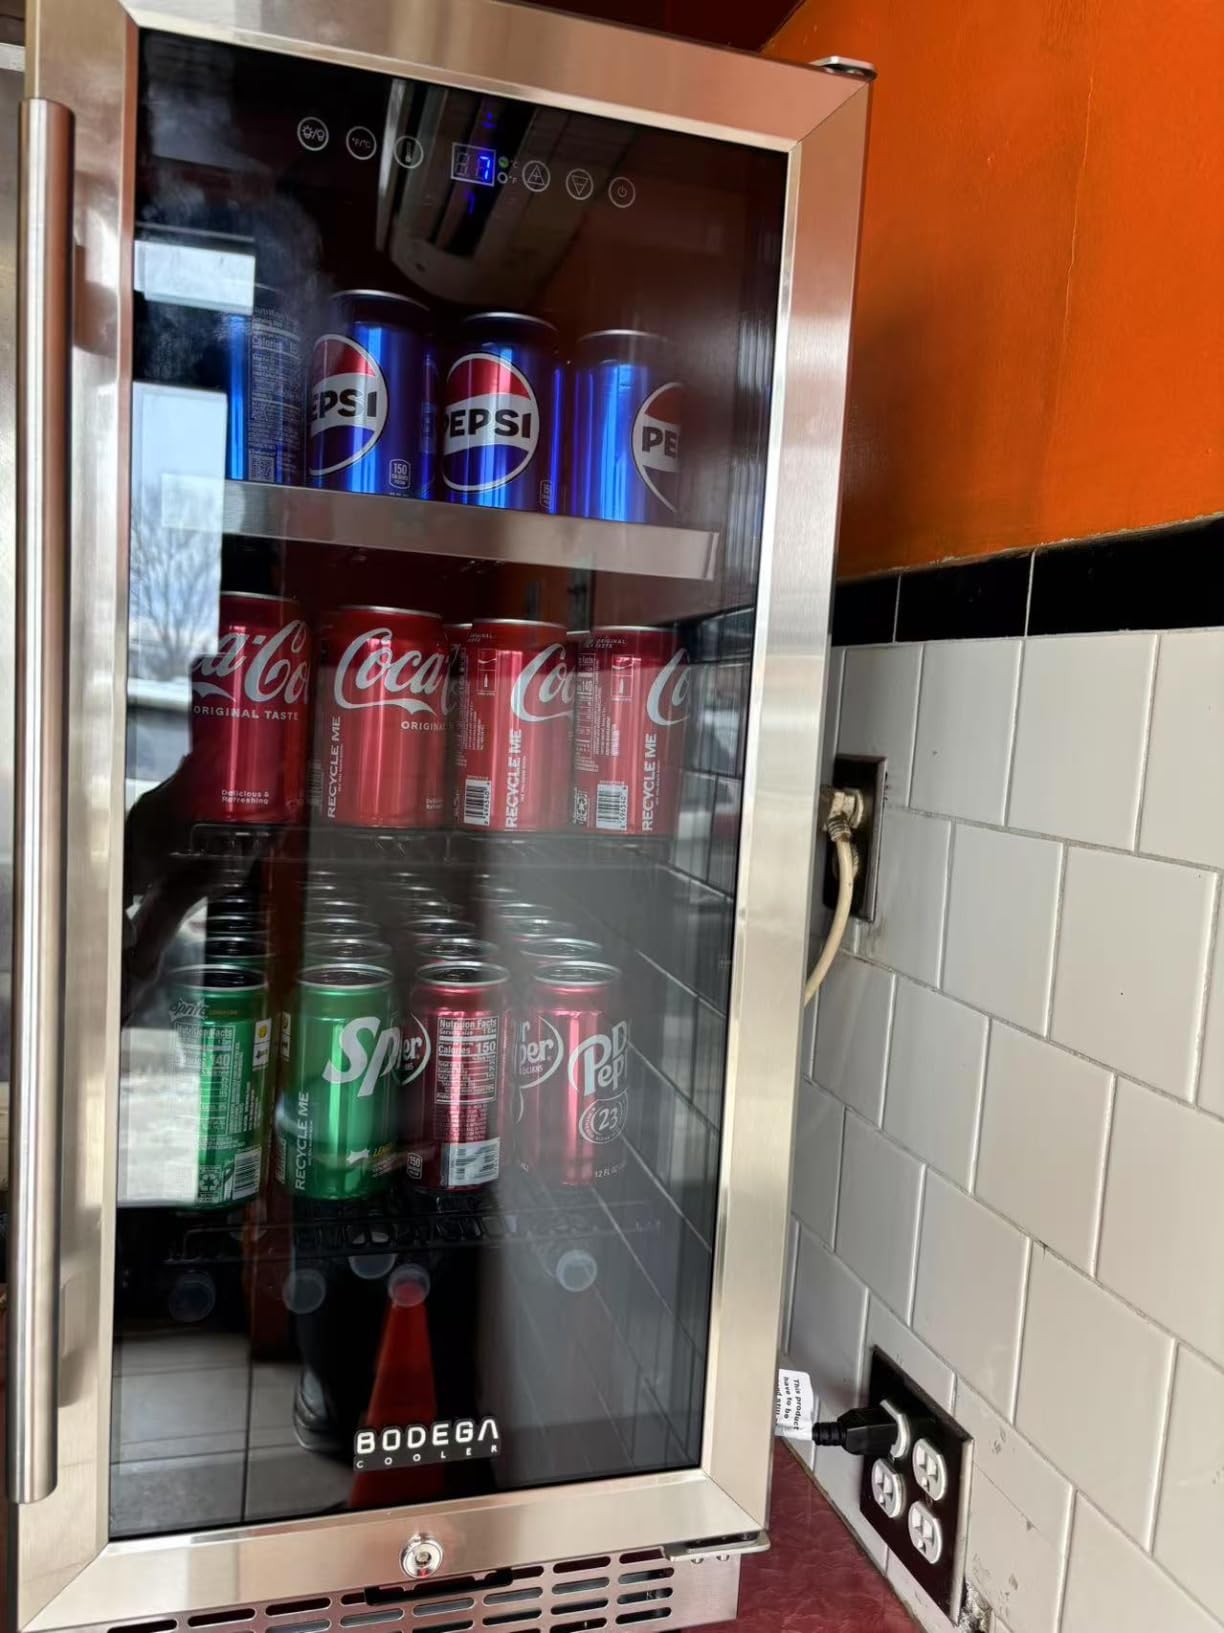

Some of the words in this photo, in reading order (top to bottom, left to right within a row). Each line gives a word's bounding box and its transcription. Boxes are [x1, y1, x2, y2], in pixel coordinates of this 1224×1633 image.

[444, 408, 532, 439] EPSI
[193, 705, 260, 719] ORIGINAL
[264, 710, 299, 721] TASTE
[330, 715, 341, 742] ME
[509, 728, 522, 755] ME
[645, 733, 657, 758] ME
[327, 744, 339, 818] RECYCLE
[505, 757, 520, 828] RECYCLE
[642, 761, 656, 832] RECYCLE
[298, 1091, 309, 1117] ME
[598, 1107, 618, 1131] 23
[295, 1119, 307, 1191] RECYCLE
[356, 1418, 499, 1455] BODEGA
[356, 1444, 498, 1469] COOLER
